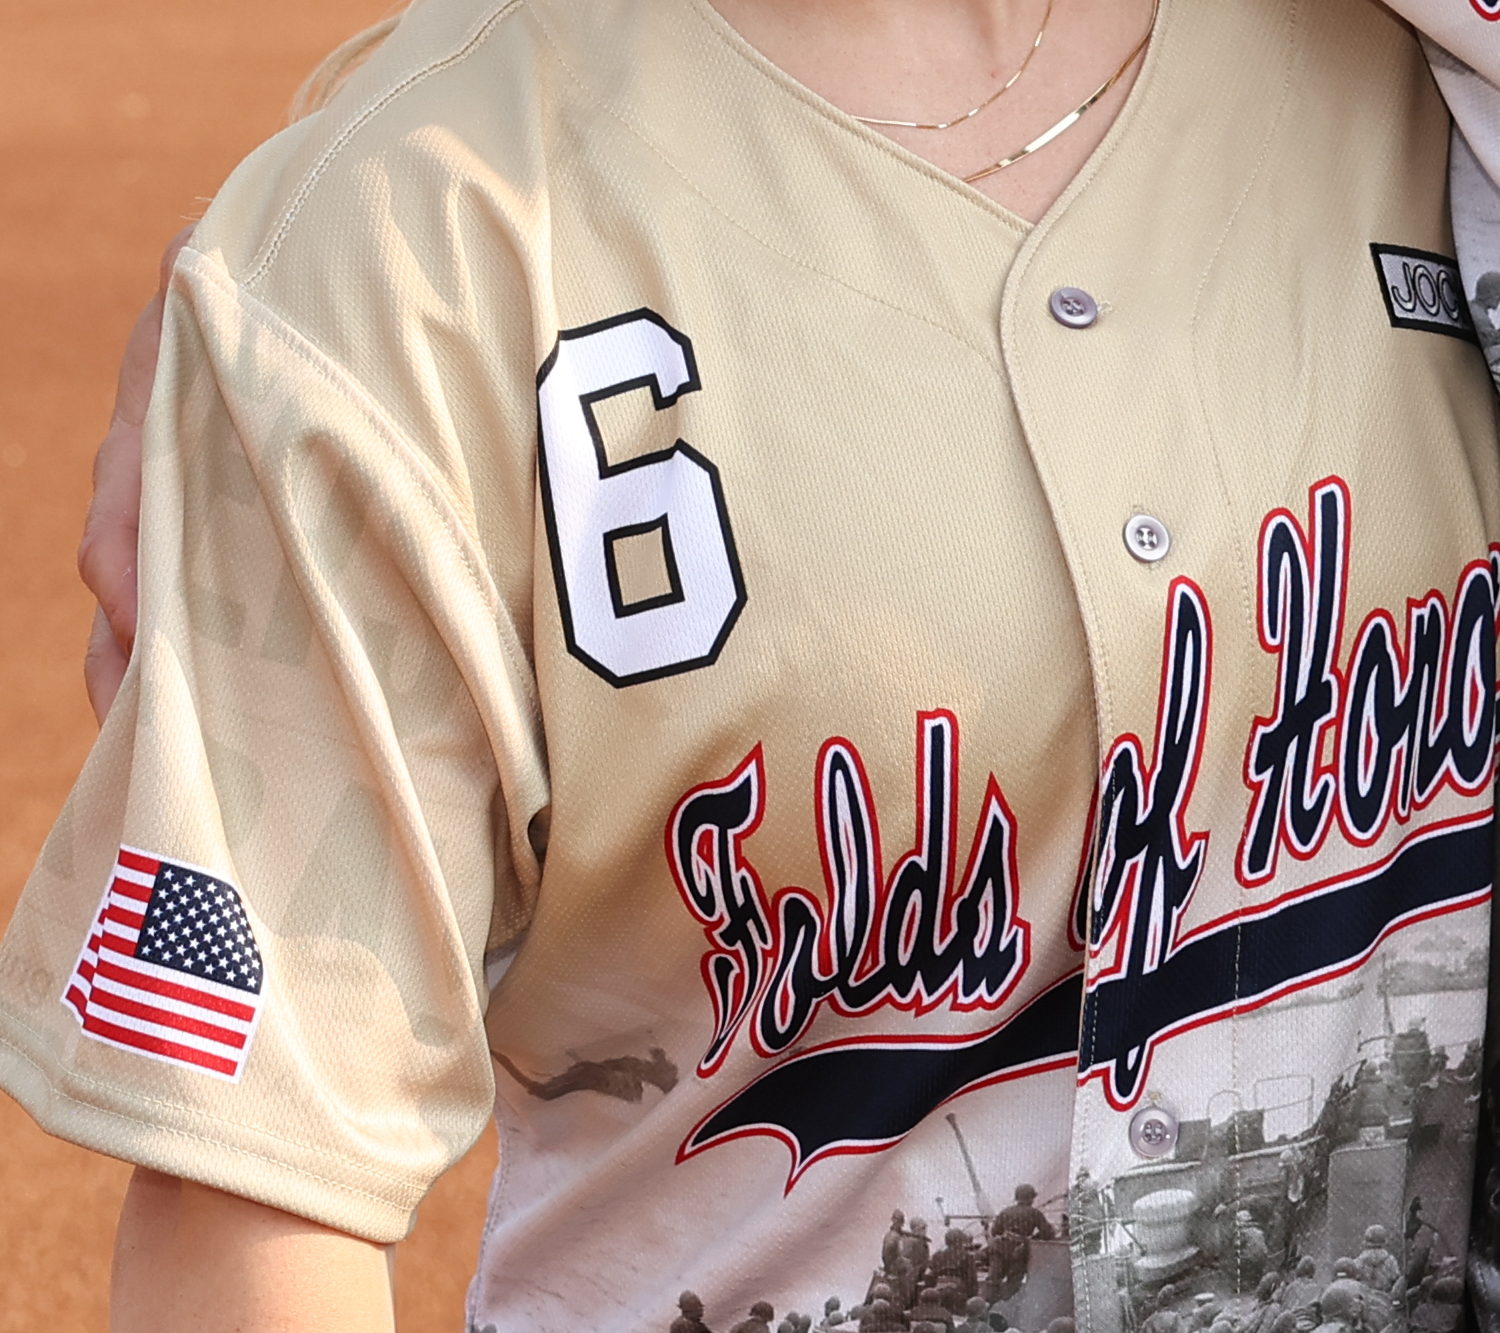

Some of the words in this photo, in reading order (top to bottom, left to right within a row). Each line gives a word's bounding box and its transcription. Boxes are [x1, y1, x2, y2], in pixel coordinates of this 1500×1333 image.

[537, 307, 747, 689] 6
[664, 709, 1030, 1078] Folds
[1070, 575, 1210, 1109] of
